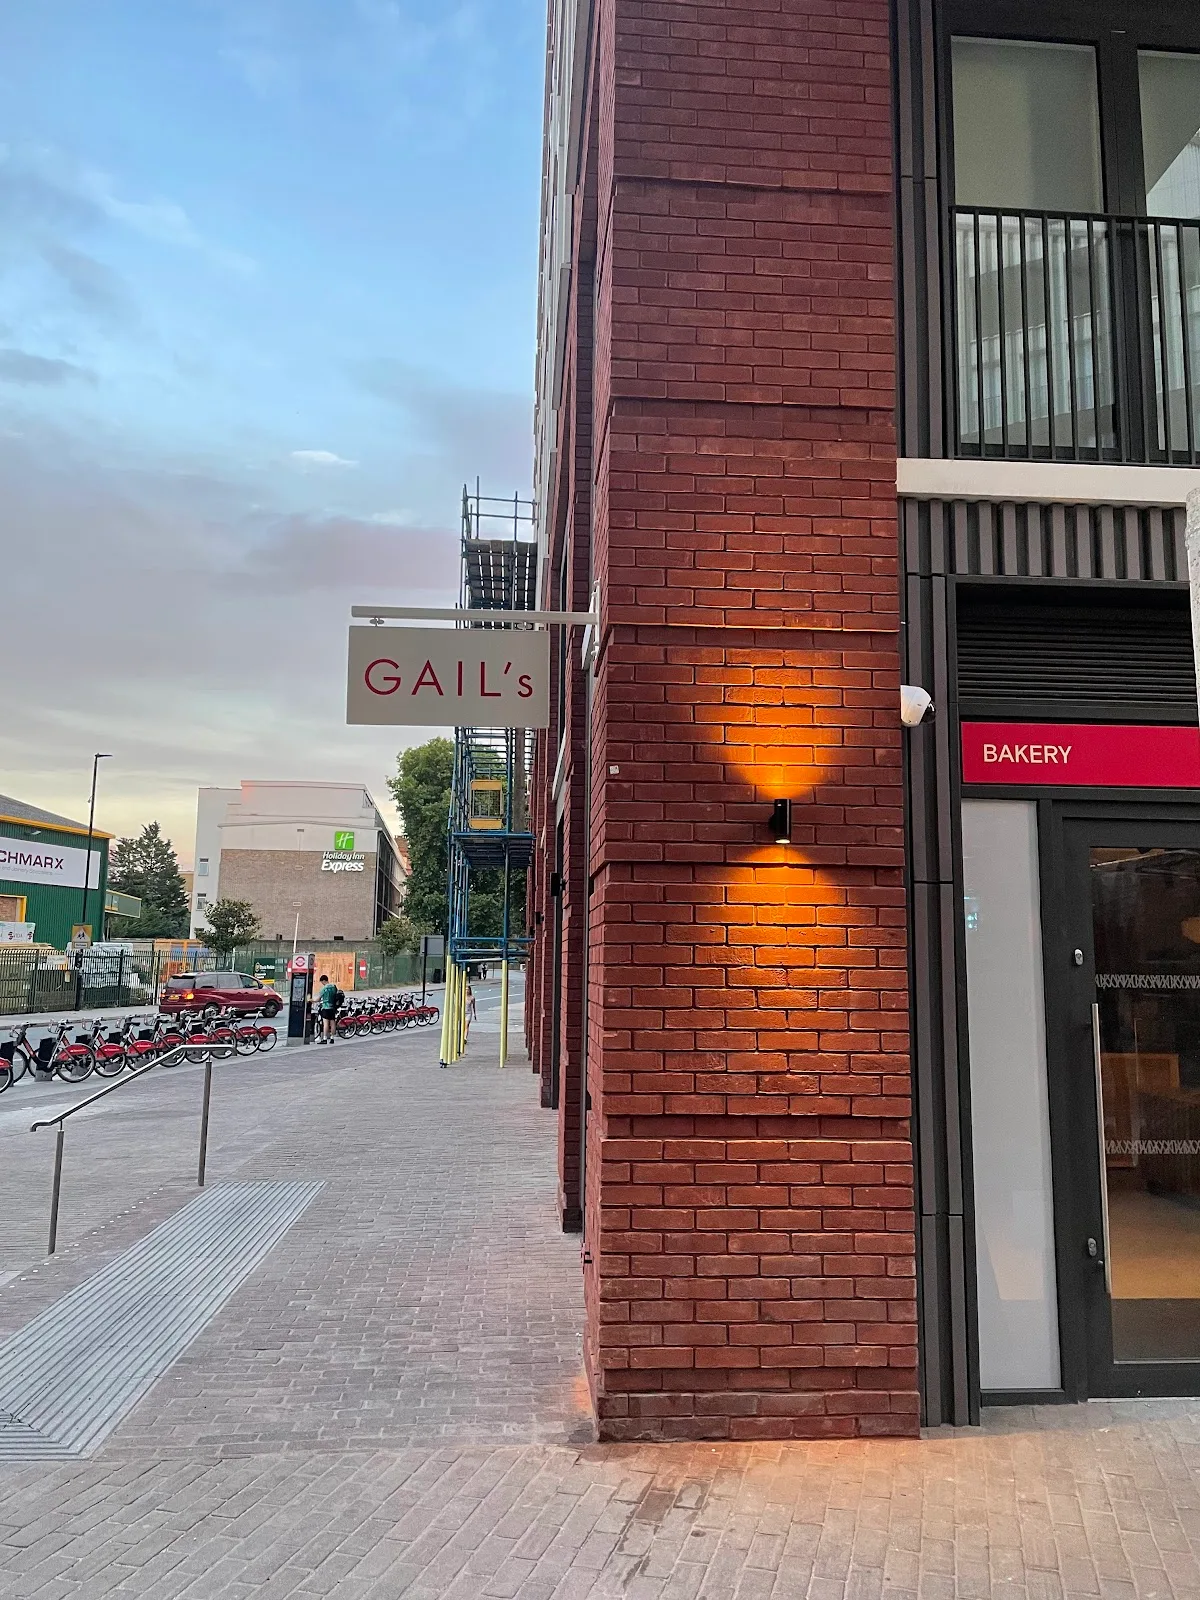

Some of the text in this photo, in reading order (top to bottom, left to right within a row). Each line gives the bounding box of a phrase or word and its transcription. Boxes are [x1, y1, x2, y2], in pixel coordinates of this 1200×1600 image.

[364, 658, 534, 698] GAIL's
[983, 743, 1072, 764] BAKERY
[322, 851, 365, 862] Holiday Inn
[321, 860, 365, 874] Express
